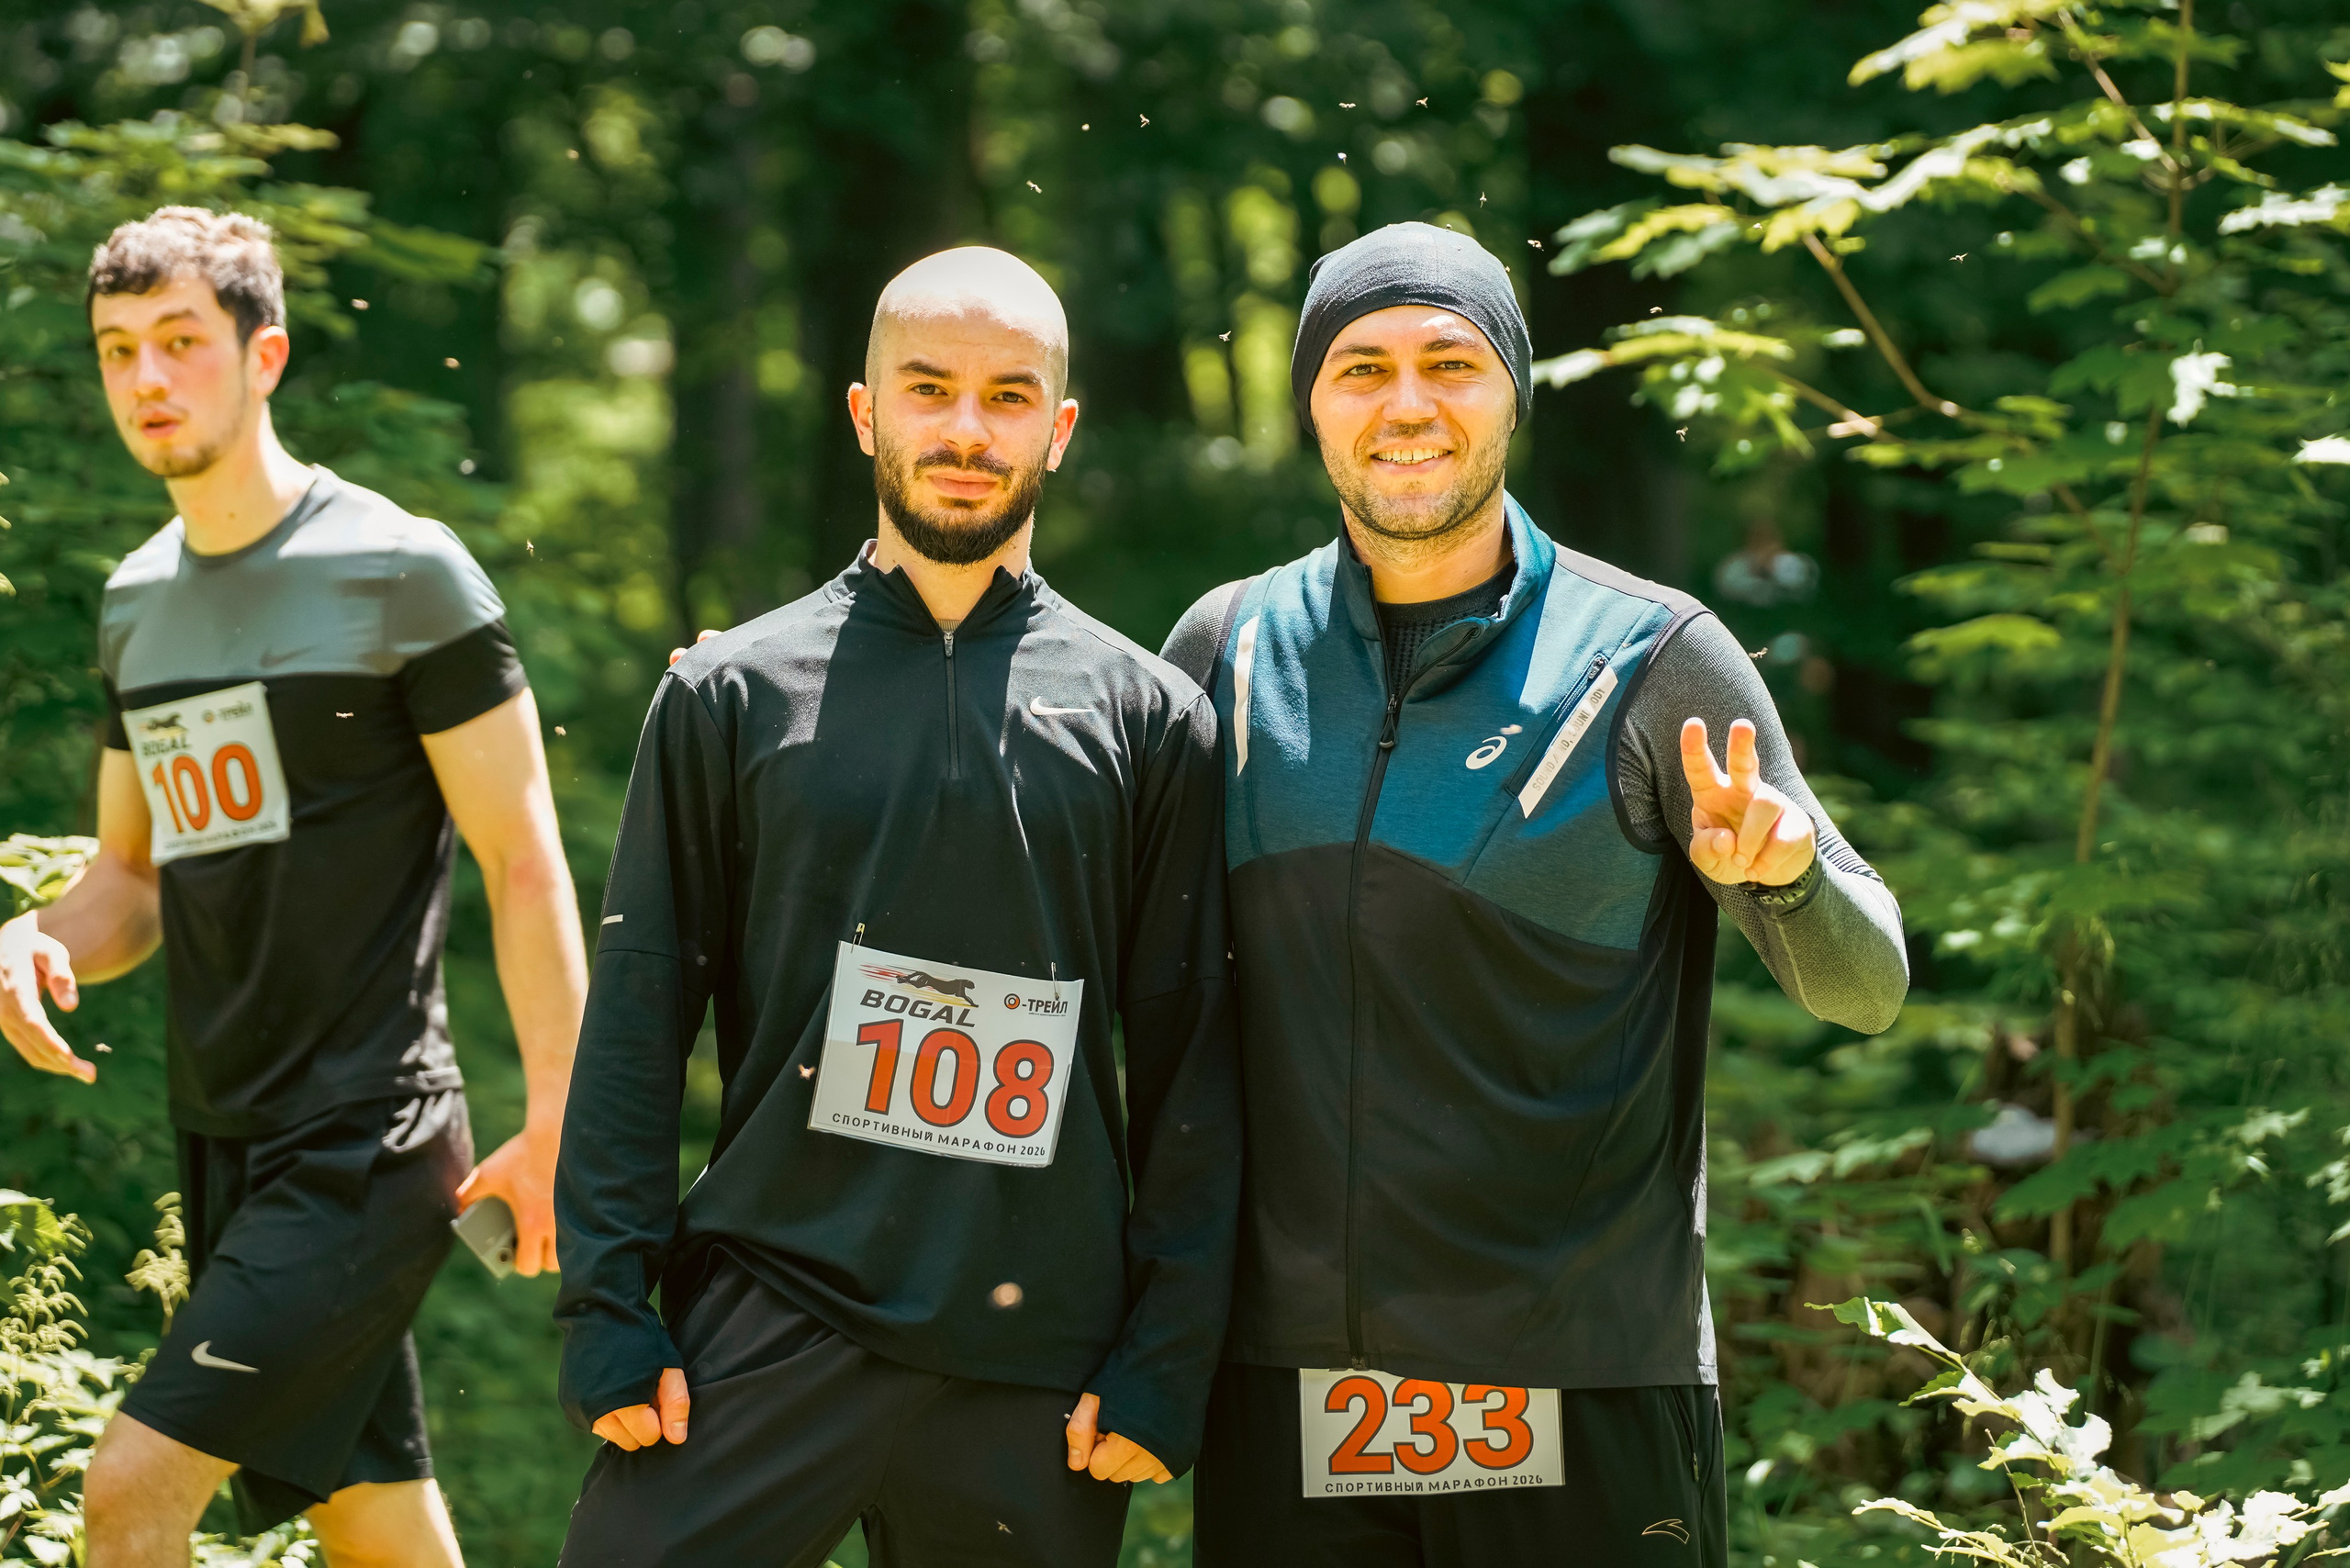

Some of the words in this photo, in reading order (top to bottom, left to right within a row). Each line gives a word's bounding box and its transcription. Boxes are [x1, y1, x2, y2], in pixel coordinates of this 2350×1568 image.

[1589, 689, 1605, 708] ODY
[152, 745, 263, 834] 100
[860, 989, 976, 1027] BOGAL
[856, 1018, 1055, 1138] 108
[832, 1113, 933, 1142] СПОРТИВНЫЙ
[938, 1134, 1016, 1154] МАРАФОН
[1021, 1146, 1046, 1156] 2026
[1325, 1375, 1534, 1475] 233
[1325, 1482, 1424, 1493] СПОРТИВНЫЙ
[1428, 1476, 1508, 1491] МАРАФОН
[1513, 1474, 1543, 1485] 2026
